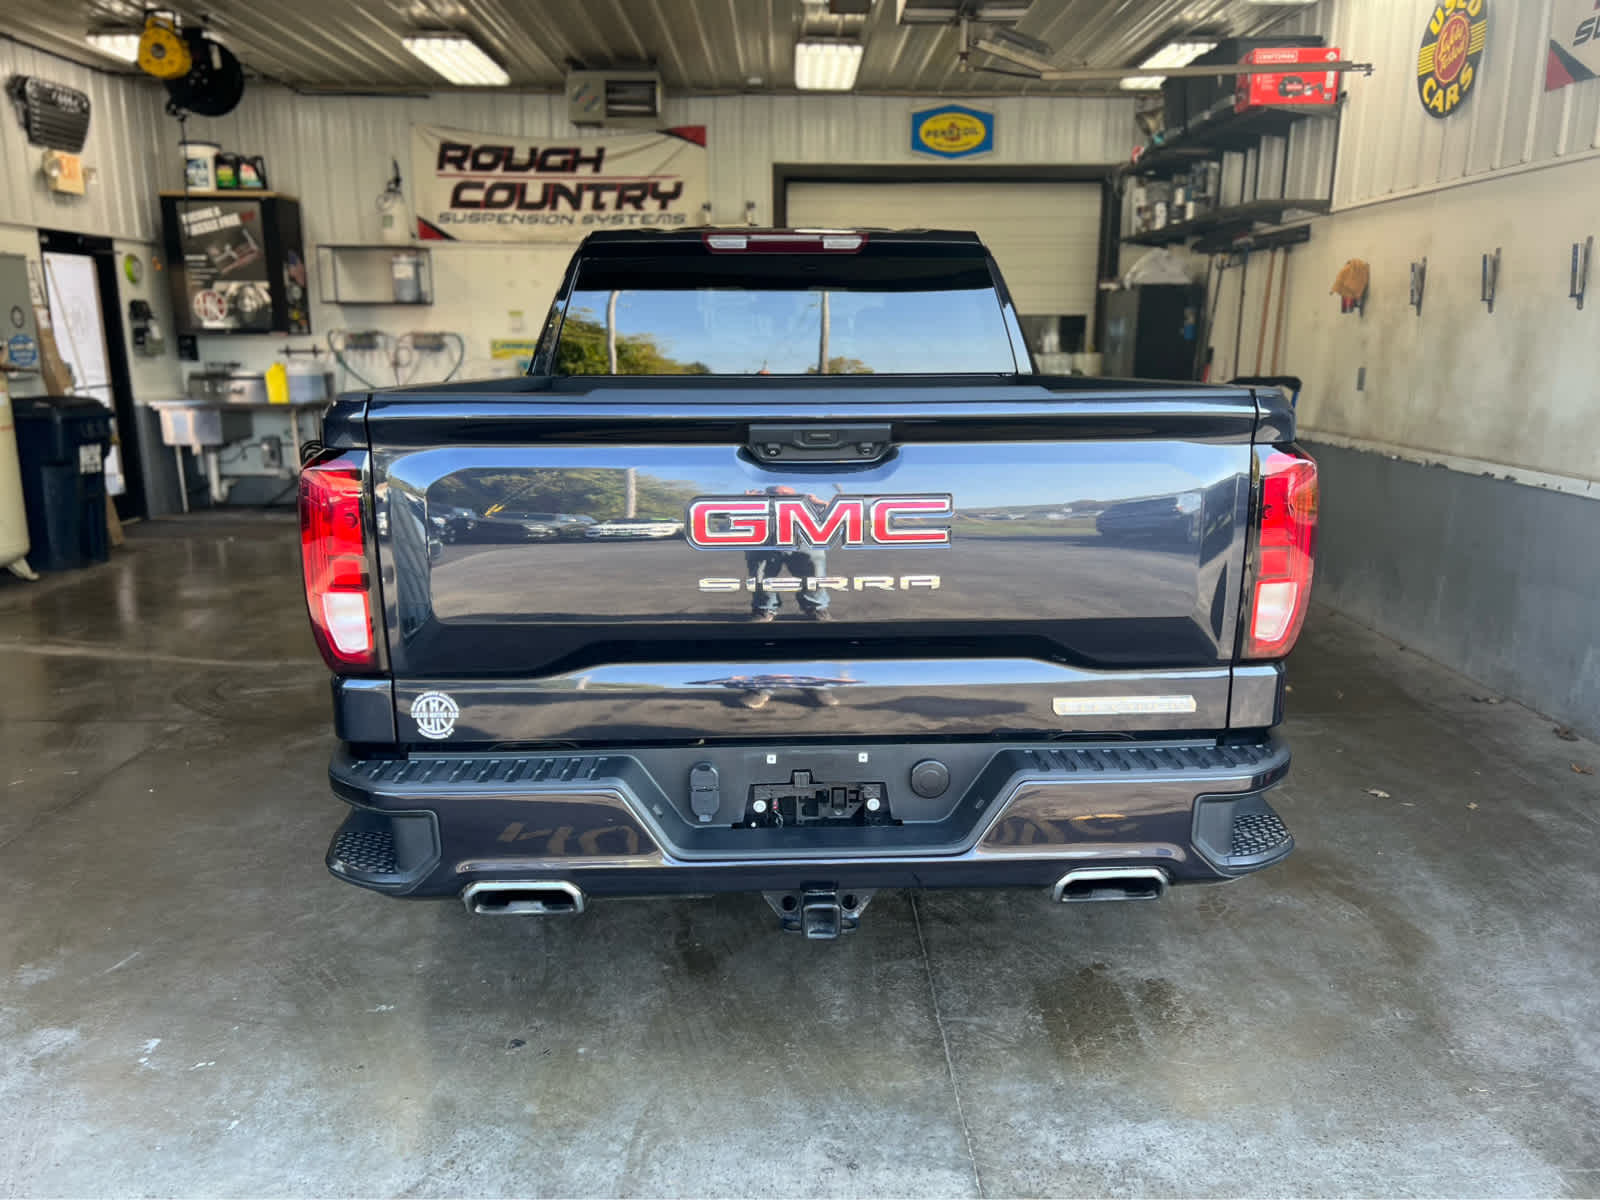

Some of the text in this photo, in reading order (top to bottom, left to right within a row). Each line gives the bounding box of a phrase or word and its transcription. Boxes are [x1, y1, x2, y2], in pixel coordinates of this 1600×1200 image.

[1573, 16, 1600, 46] S
[1422, 62, 1473, 112] CARS
[437, 142, 605, 173] ROUGH
[450, 181, 683, 211] COUNTRY
[437, 212, 686, 225] SUSPENSION SYSTEMS
[687, 495, 952, 549] GMC
[698, 575, 941, 592] SIERRA
